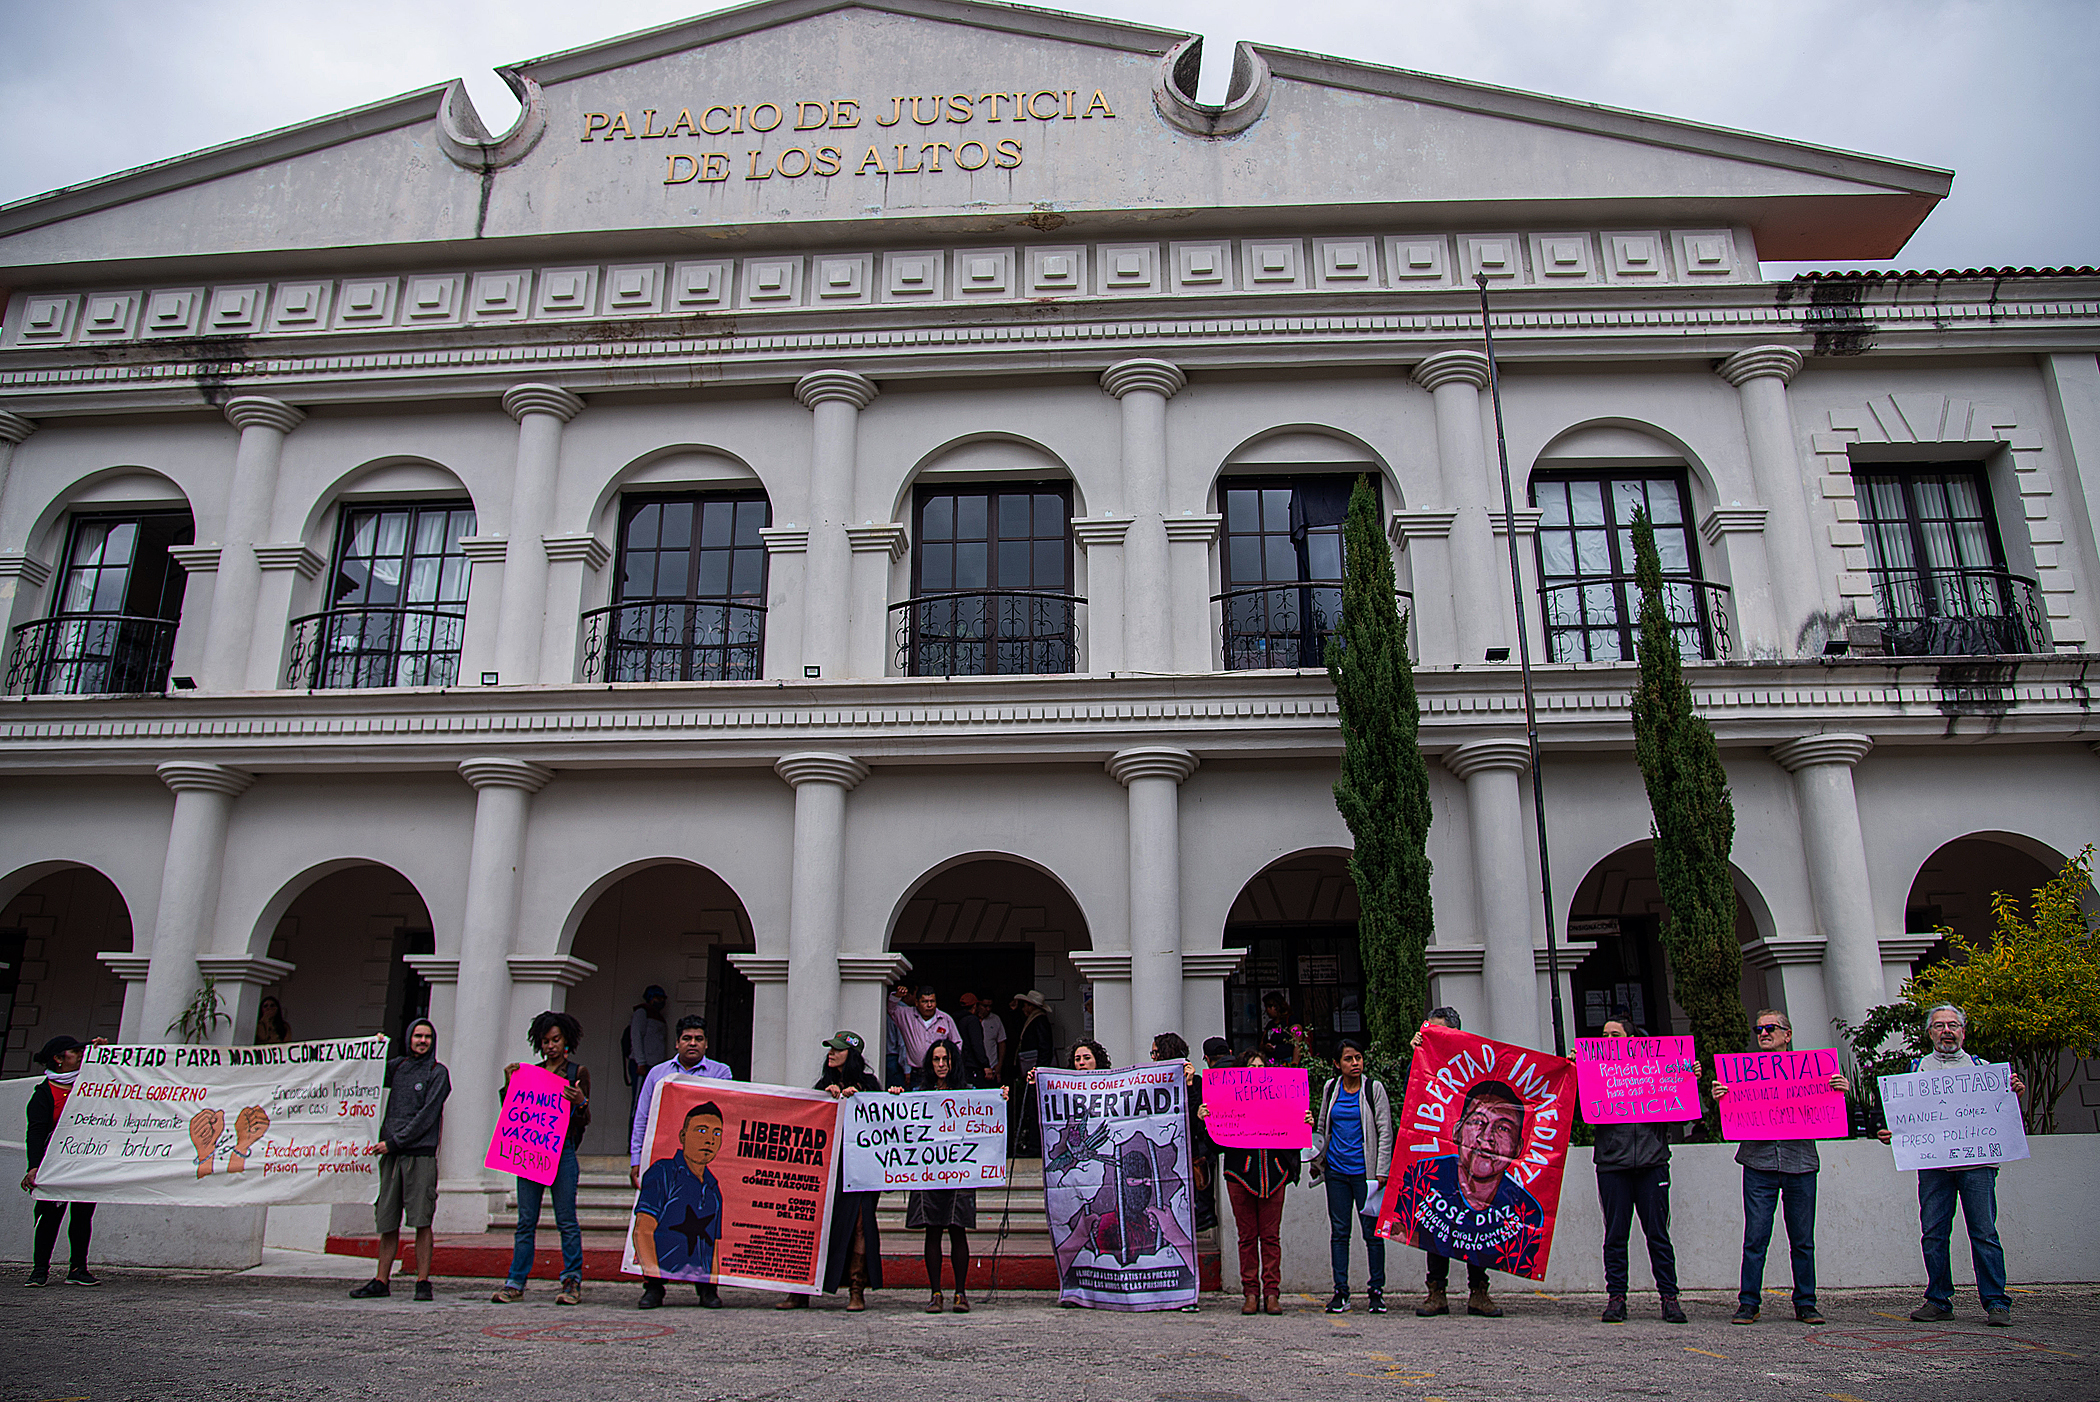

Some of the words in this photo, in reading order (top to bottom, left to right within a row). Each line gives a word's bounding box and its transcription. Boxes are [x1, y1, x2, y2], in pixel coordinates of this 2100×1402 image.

[580, 102, 783, 142] PALACIO
[794, 98, 861, 131] DE
[876, 88, 1115, 128] JUSTICIA
[664, 152, 731, 184] DE
[745, 146, 842, 181] LOS
[855, 138, 1023, 175] ALTOS
[85, 1045, 167, 1067] LIBERTAD
[175, 1048, 221, 1067] PARA
[228, 1047, 286, 1066] MANUEL
[1579, 1040, 1622, 1062] MANUEL
[1674, 1039, 1683, 1056] V
[1599, 1063, 1639, 1078] Rehén
[1642, 1060, 1661, 1076] del
[1721, 1052, 1836, 1083] LIBERTAD
[77, 1079, 121, 1098] REHÉN
[122, 1084, 143, 1100] DEL
[146, 1085, 207, 1102] GOBIERNO
[1047, 1080, 1087, 1090] MANUEL
[1090, 1079, 1125, 1090] GÓMEZ
[1128, 1072, 1174, 1085] VÁZQUEZ
[1648, 1085, 1656, 1095] 3
[513, 1090, 564, 1114] MANUEL
[1044, 1086, 1180, 1122] ¡LIBERTAD!
[1410, 1044, 1496, 1152] LIBERTAD
[1728, 1087, 1780, 1104] INMEDIATA
[288, 1105, 304, 1118] por
[309, 1104, 329, 1115] casi
[337, 1100, 348, 1116] 3
[350, 1100, 376, 1118] años
[508, 1107, 558, 1129] GÓMEZ
[855, 1101, 934, 1123] MANUEL
[940, 1098, 994, 1119] Rehén
[1590, 1096, 1685, 1118] JUSTICIA
[1896, 1111, 1949, 1125] MANUEL
[74, 1113, 117, 1128] Detenido
[123, 1113, 183, 1134] ilegalmente
[1505, 1052, 1559, 1189] INMEDIATA
[502, 1125, 560, 1153] VÁZQUEZ
[739, 1119, 827, 1150] LIBERTAD
[856, 1124, 934, 1148] GOMEZ
[939, 1120, 956, 1132] del
[966, 1119, 1004, 1134] Estado
[1901, 1133, 1936, 1148] PRESO
[62, 1136, 111, 1156] Recibió
[121, 1137, 173, 1157] tortura
[319, 1140, 330, 1157] el
[361, 1140, 374, 1157] de
[737, 1141, 824, 1167] INMEDIATA
[875, 1142, 979, 1168] VAZQUEZ
[1949, 1143, 2002, 1159] EZLN
[263, 1161, 298, 1177] prisión
[317, 1160, 372, 1177] preventiva
[755, 1169, 781, 1179] PARA
[783, 1172, 820, 1184] MANUEL
[884, 1169, 918, 1183] base
[921, 1166, 936, 1181] de
[938, 1169, 970, 1184] apoyo
[980, 1165, 1006, 1179] EZLN
[742, 1175, 775, 1187] GÓMEZ
[777, 1179, 820, 1193] VÁZQUEZ
[752, 1200, 774, 1210] BASE
[776, 1203, 787, 1211] DE
[788, 1205, 816, 1214] APOYO
[788, 1197, 816, 1207] COMPA
[1425, 1188, 1470, 1225] JOSÉ
[1476, 1205, 1516, 1226] DÍAZ
[777, 1211, 792, 1219] DEL
[1414, 1210, 1435, 1233] BASE
[1437, 1231, 1449, 1242] DE
[1453, 1239, 1483, 1251] APOYO
